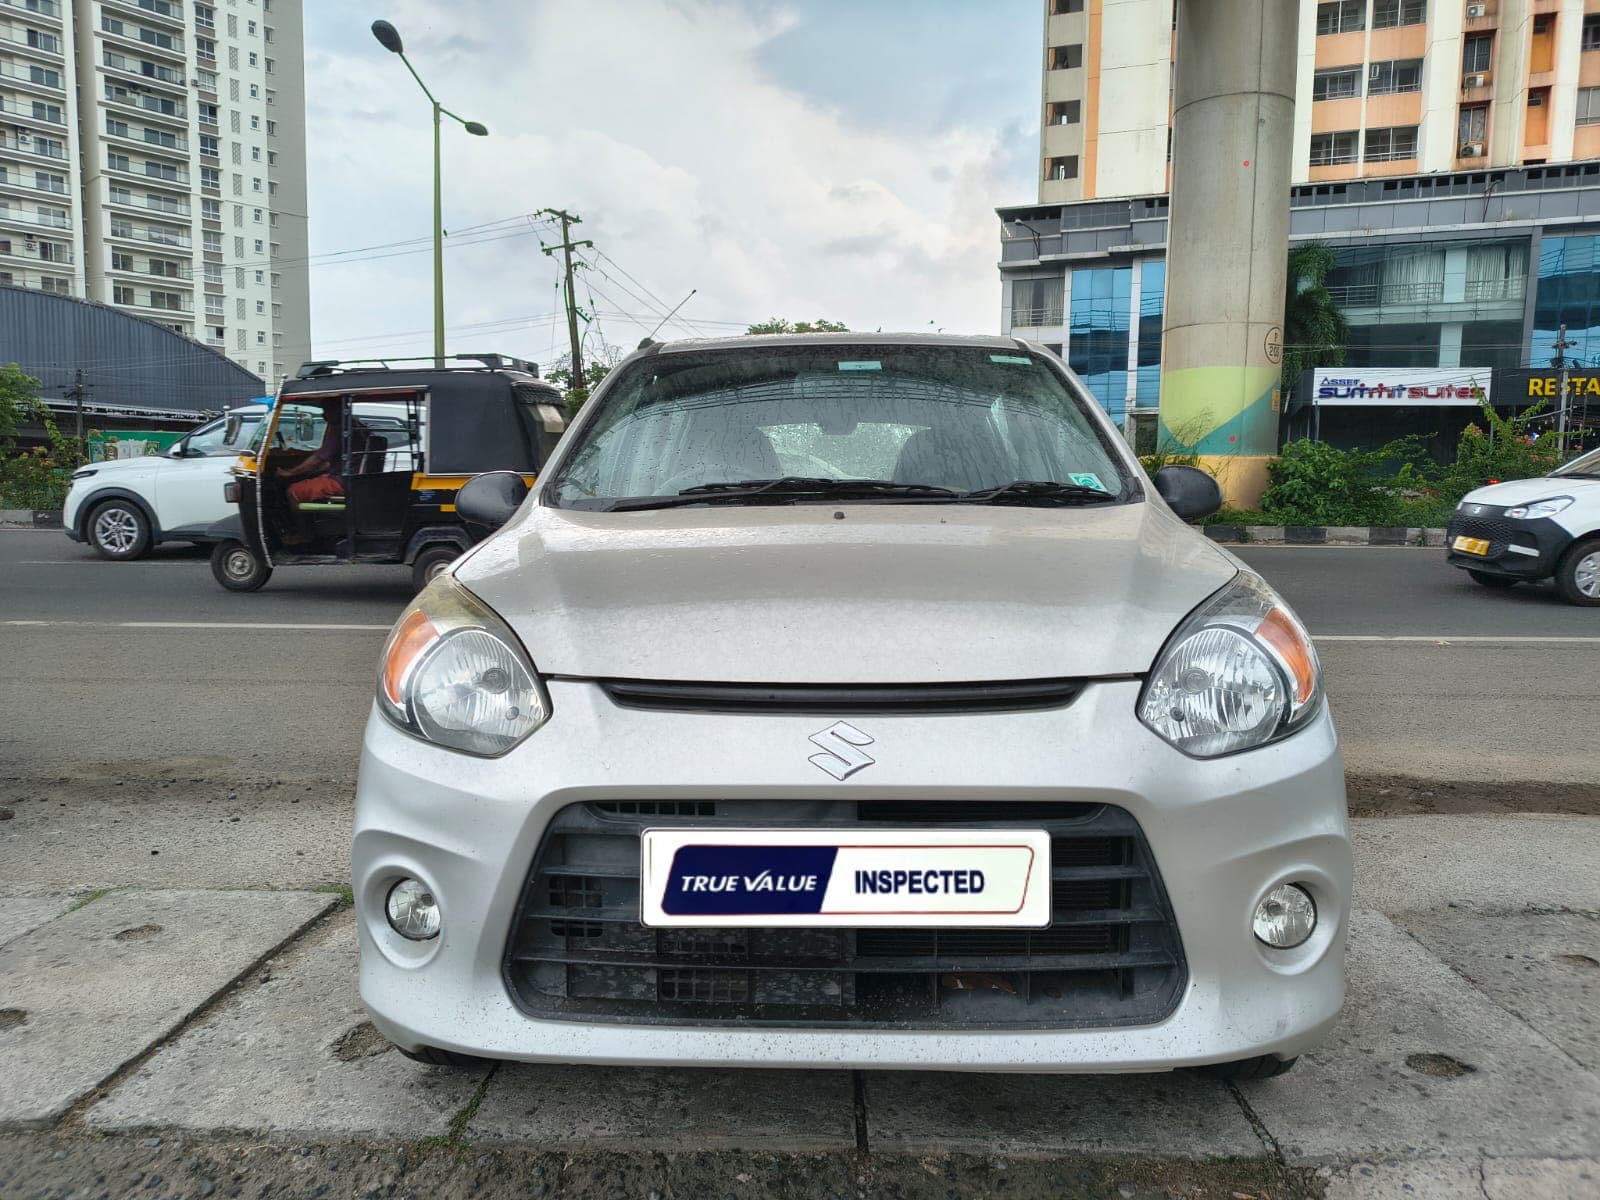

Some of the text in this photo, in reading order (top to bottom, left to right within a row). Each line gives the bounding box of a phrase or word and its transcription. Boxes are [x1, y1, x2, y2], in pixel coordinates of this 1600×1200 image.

[681, 869, 985, 894] TRUE VALUE INSPECTED
